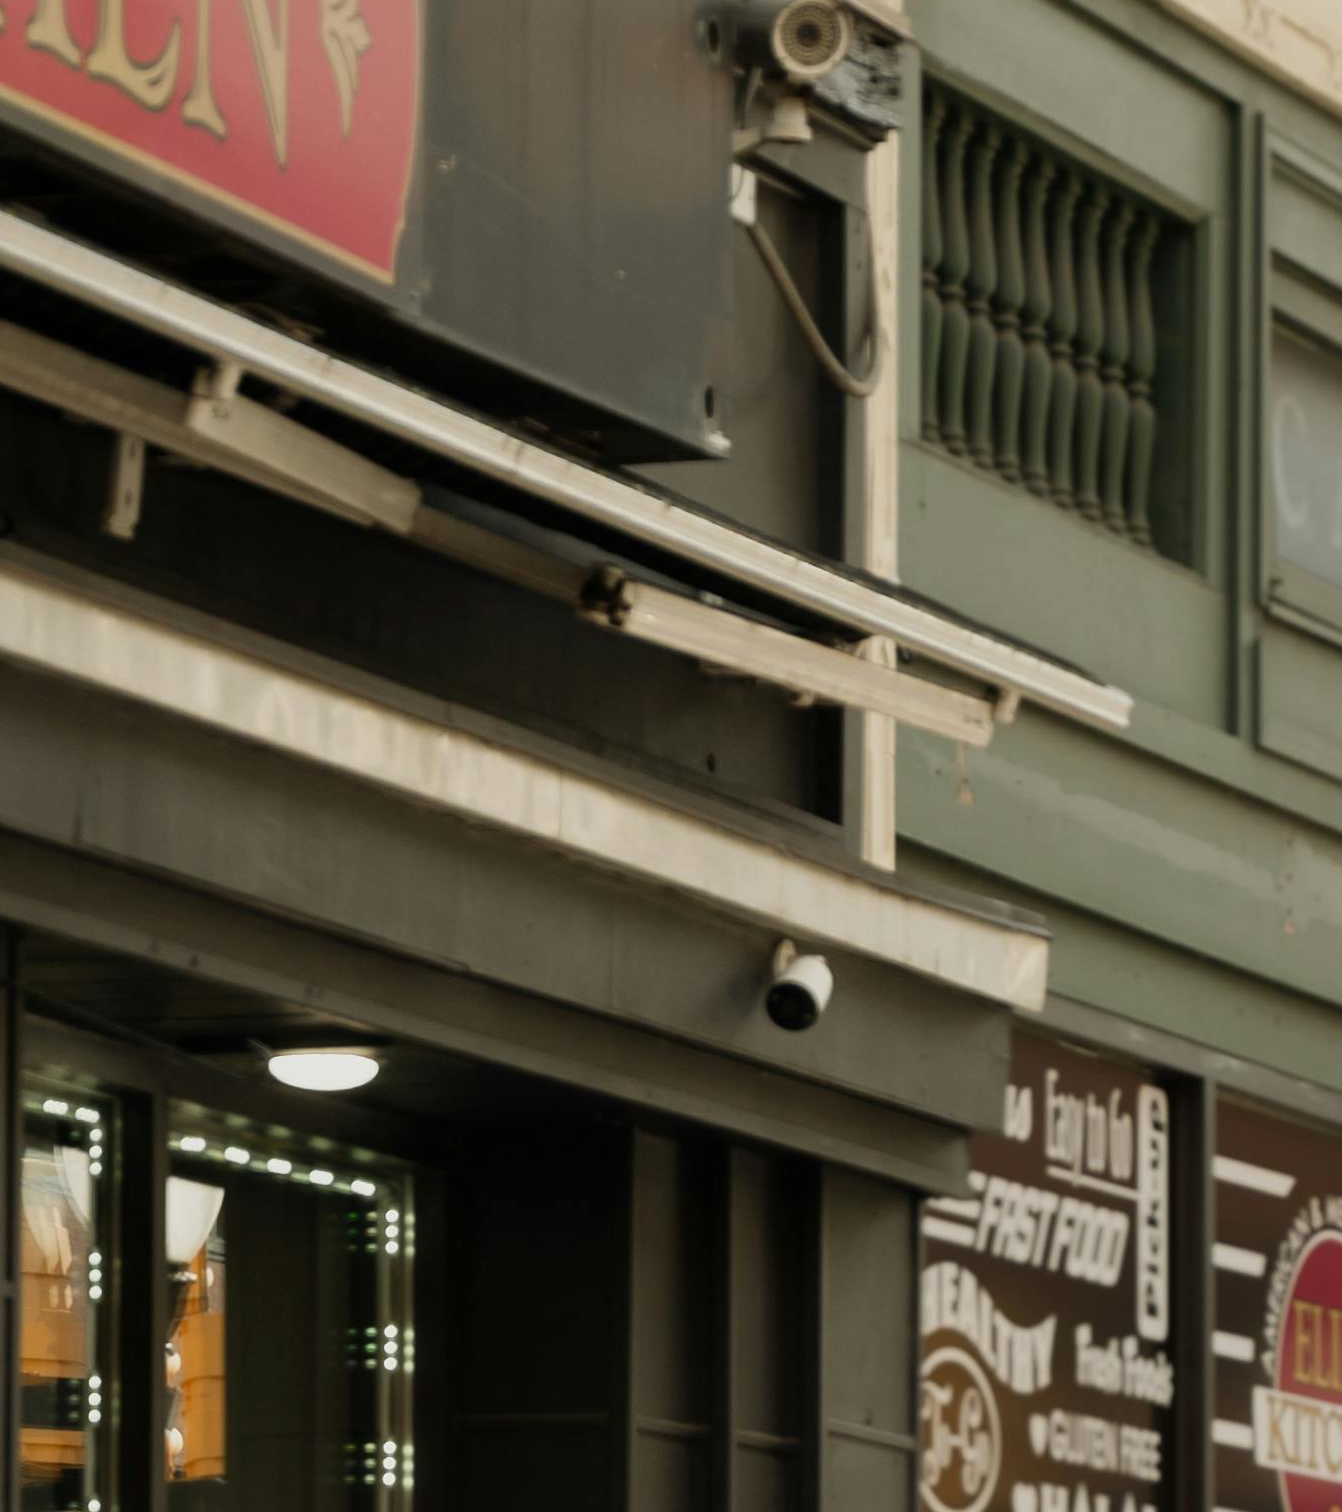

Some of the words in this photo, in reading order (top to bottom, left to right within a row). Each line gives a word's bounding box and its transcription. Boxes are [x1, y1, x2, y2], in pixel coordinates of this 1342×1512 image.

[975, 1172, 1061, 1270] FAST
[1046, 1194, 1130, 1288] FOOD
[1048, 1406, 1119, 1474] GLUTEN
[1119, 1422, 1163, 1483] FREE
